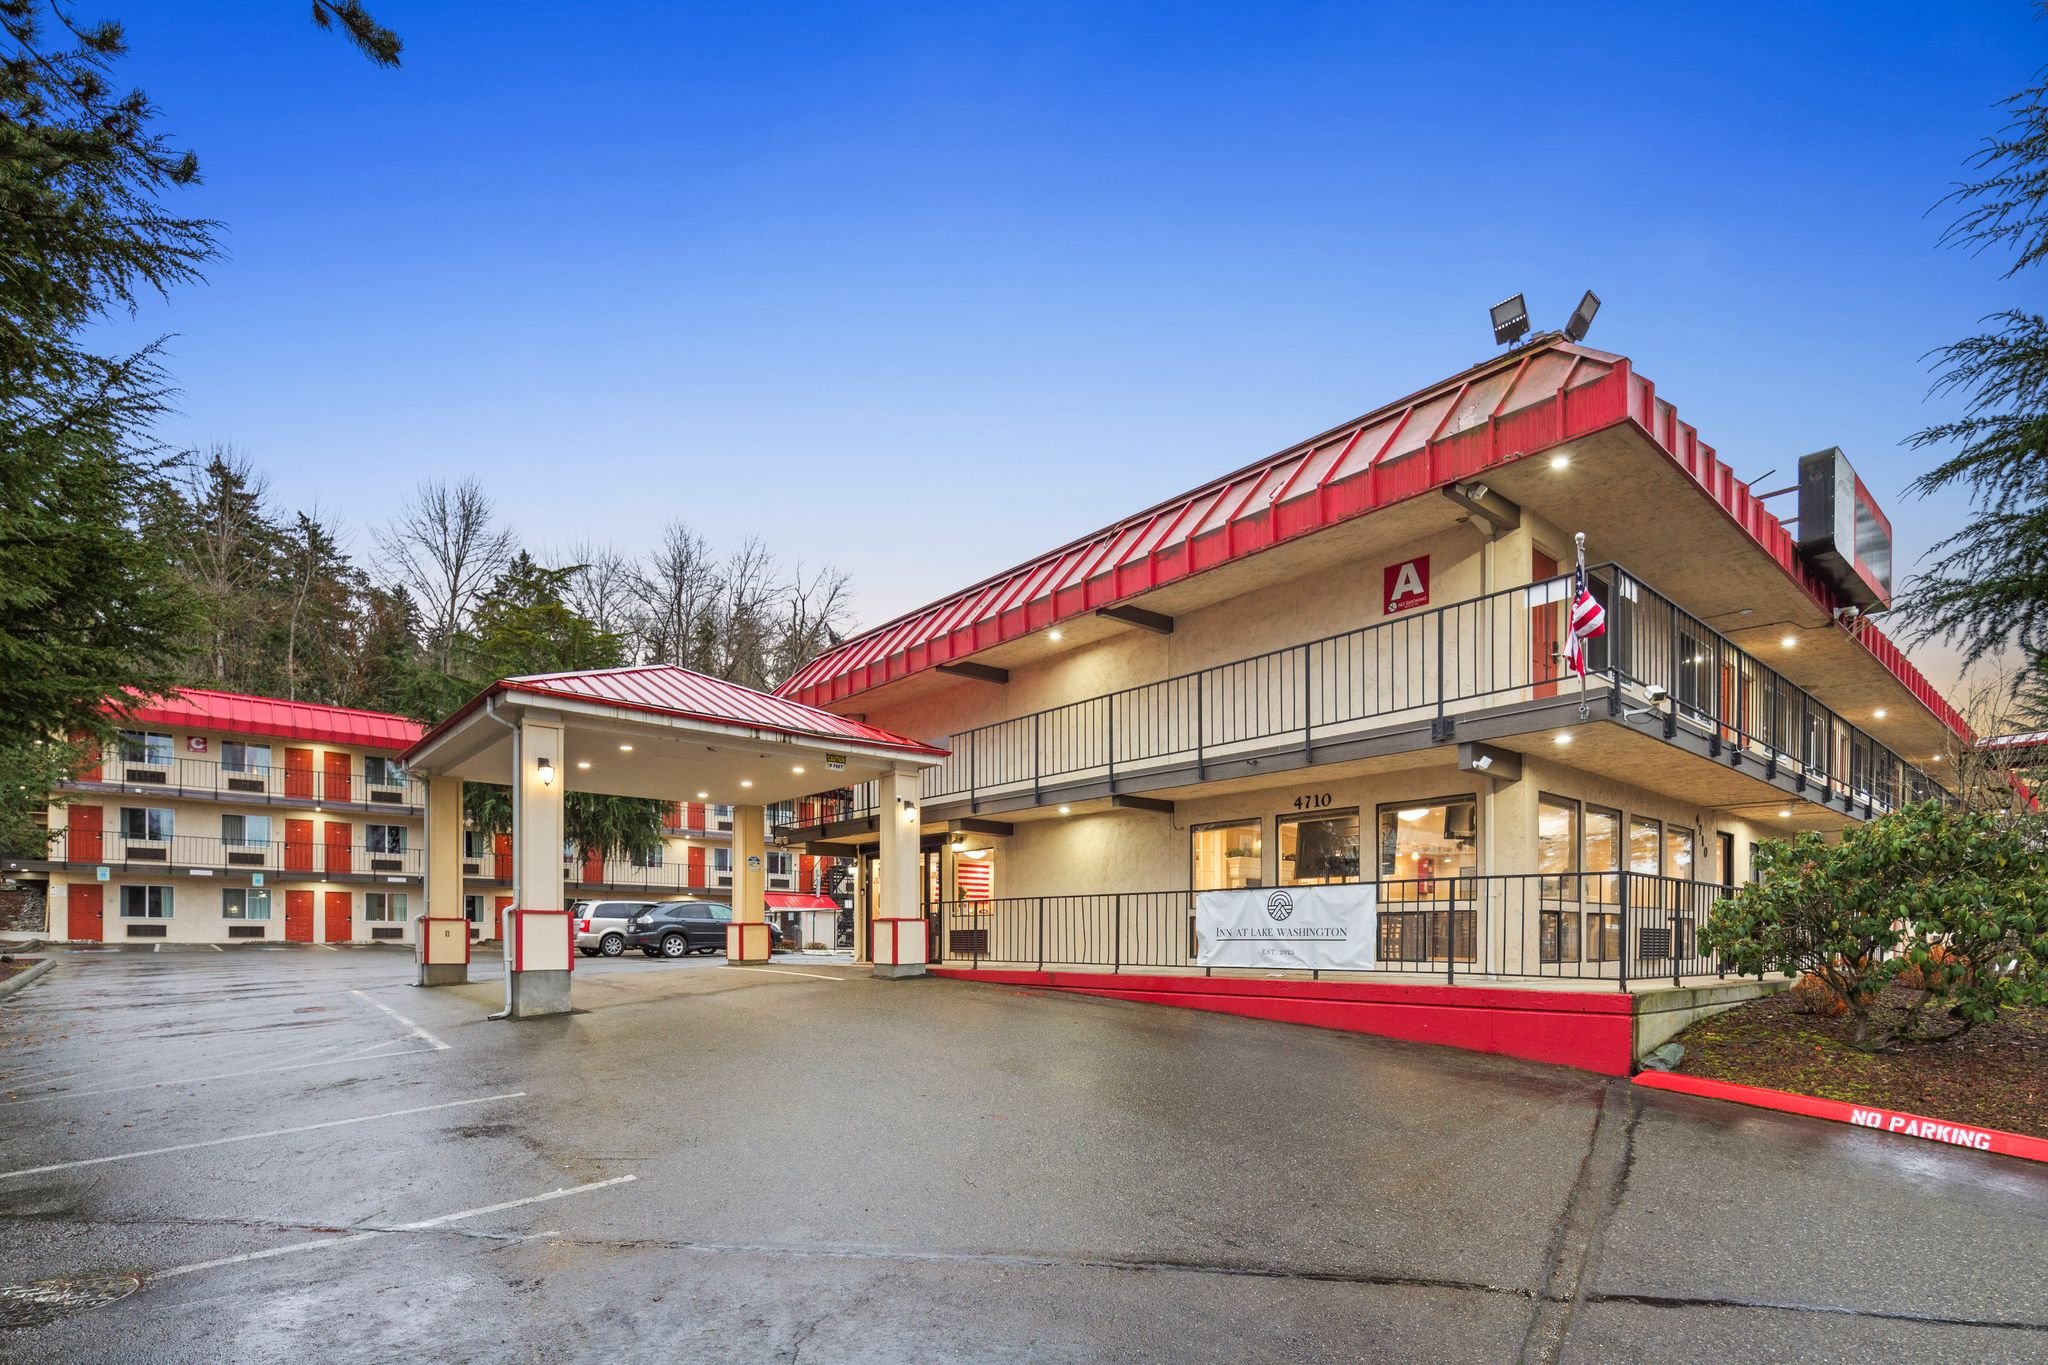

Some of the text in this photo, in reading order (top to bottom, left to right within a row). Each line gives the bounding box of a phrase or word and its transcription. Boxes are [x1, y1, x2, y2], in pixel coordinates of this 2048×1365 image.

[1391, 562, 1424, 601] A
[191, 738, 204, 749] C
[1293, 793, 1332, 810] 4710
[1695, 813, 1708, 858] 4710
[1236, 928, 1248, 937] AT
[1251, 928, 1273, 937] LAKE
[1277, 927, 1347, 937] WASHINGTON
[1850, 1109, 1992, 1150] NO PARKING
